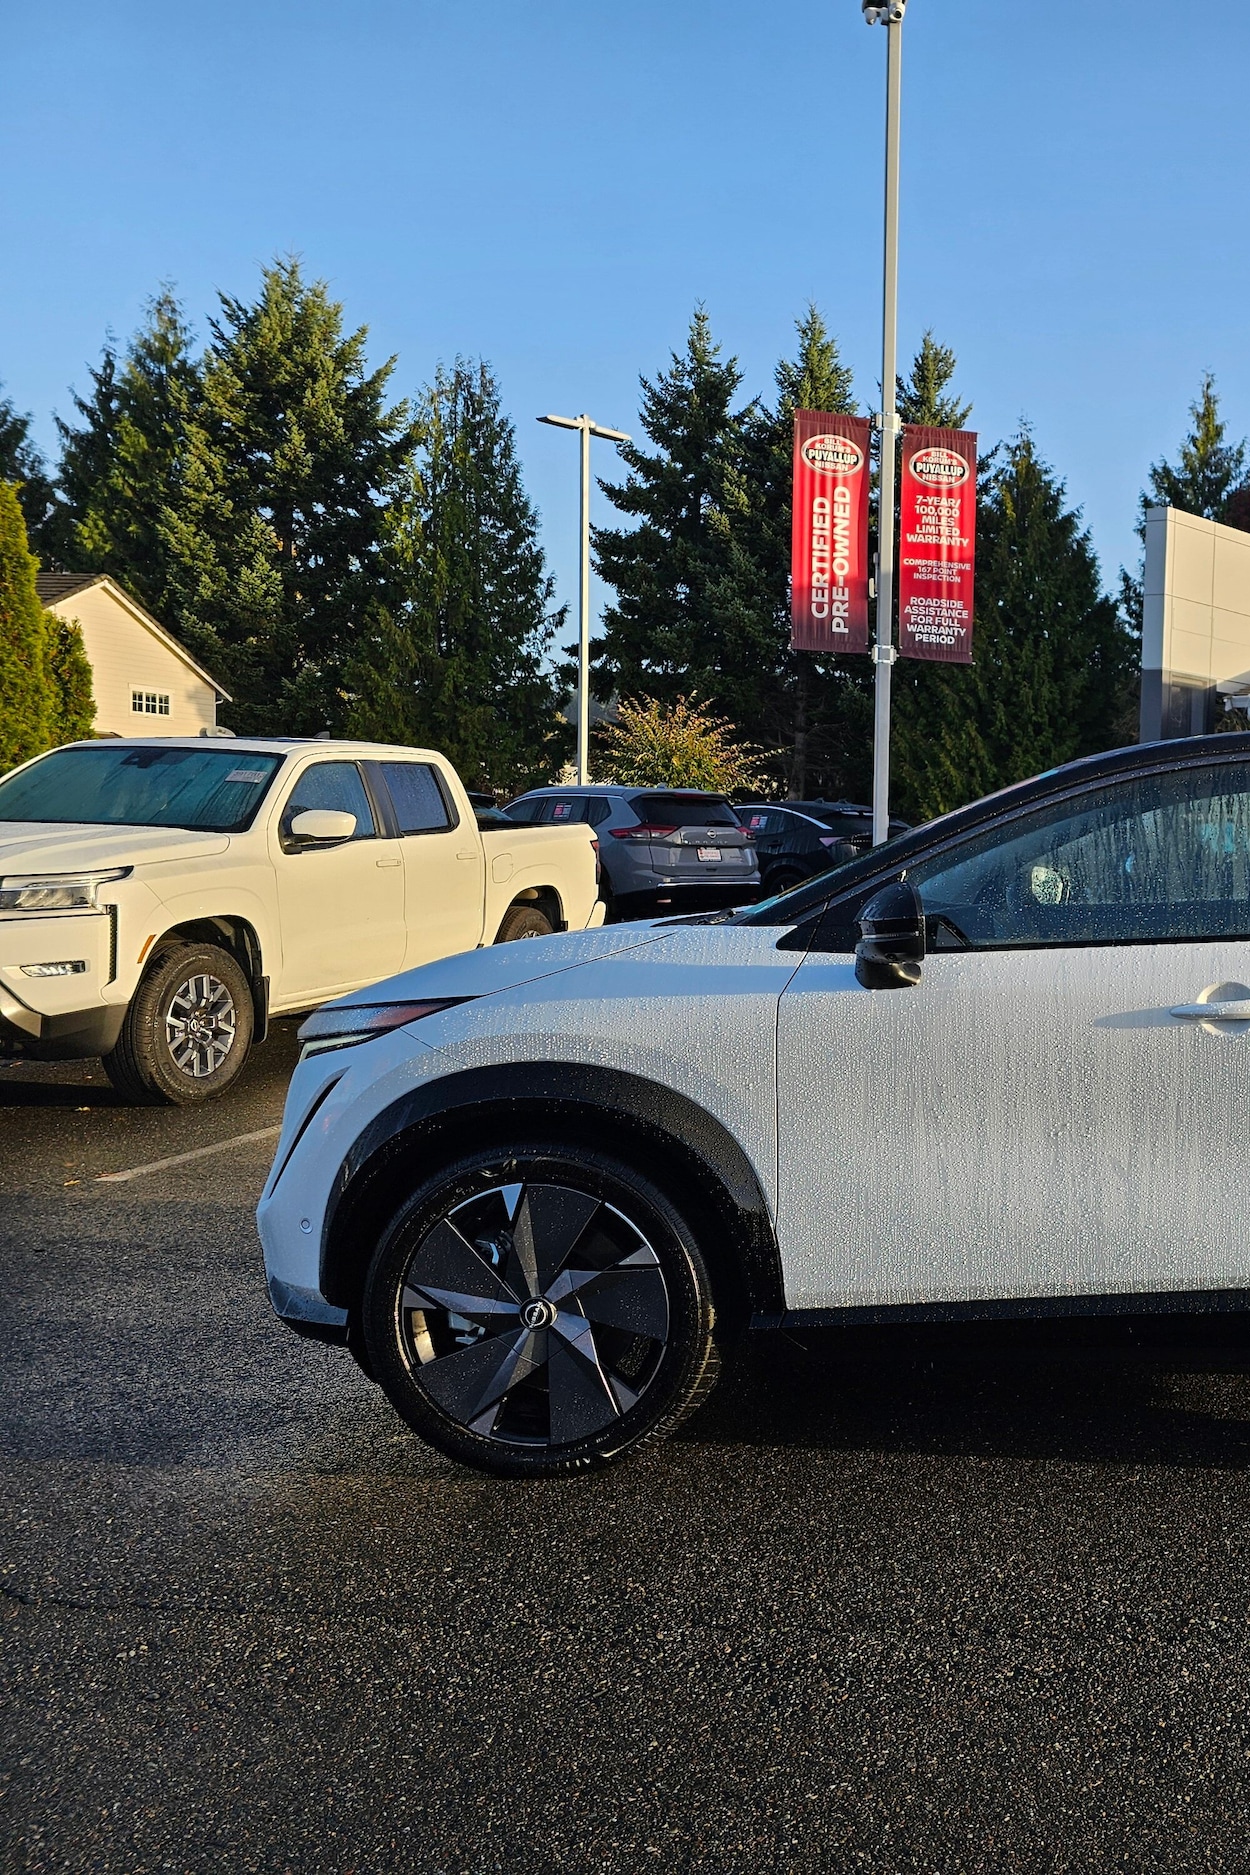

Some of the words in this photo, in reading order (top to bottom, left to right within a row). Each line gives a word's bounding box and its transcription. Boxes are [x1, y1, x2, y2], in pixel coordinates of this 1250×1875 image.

[808, 449, 857, 464] PUYALLUP
[815, 460, 848, 471] NISSAN
[916, 462, 963, 476] PUYALLUP
[922, 473, 955, 482] NISSAN
[916, 495, 961, 508] 7-YEAR/
[915, 505, 960, 517] 100,000
[922, 515, 955, 526] MILES
[916, 524, 960, 536] LIMITED
[906, 534, 969, 547] WARRANTY
[811, 497, 830, 619] CERTIFIED
[832, 486, 850, 634] PRE-OWNED
[903, 558, 971, 570] COMPREHENSIVE
[913, 573, 961, 582] INSPECTION
[933, 567, 957, 576] POINT
[910, 597, 963, 609] ROADSIDE
[904, 605, 968, 618] ASSISTANCE
[911, 615, 933, 624] FOR
[935, 617, 960, 627] FULL
[907, 624, 966, 637] WARRANTY
[915, 633, 956, 645] PERIOD
